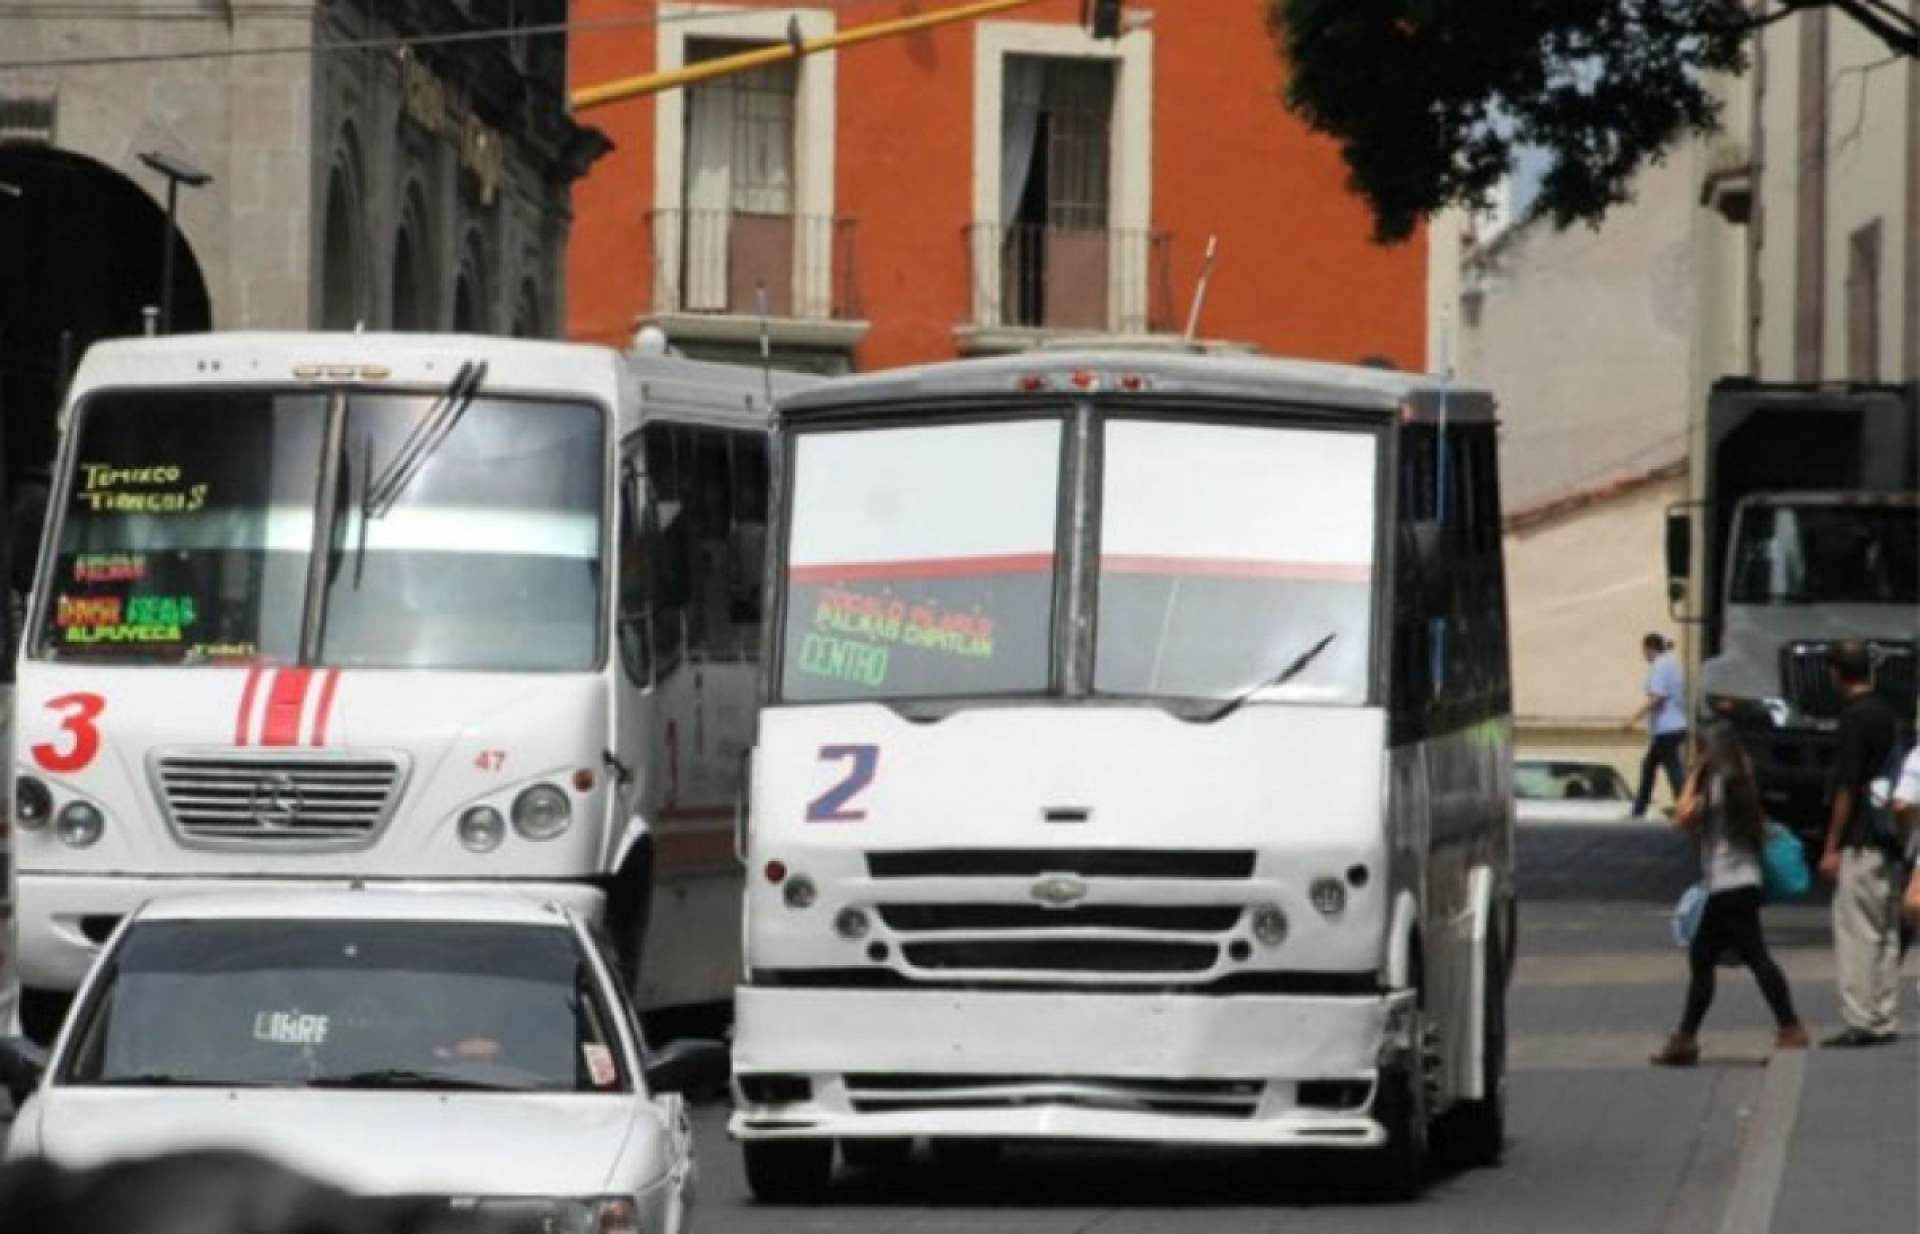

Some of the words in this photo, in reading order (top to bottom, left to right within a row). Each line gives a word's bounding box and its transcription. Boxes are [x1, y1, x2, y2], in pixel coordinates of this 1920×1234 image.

[800, 633, 889, 687] CENTRO
[31, 692, 107, 774] 3
[474, 750, 506, 772] 47
[804, 744, 880, 824] 2
